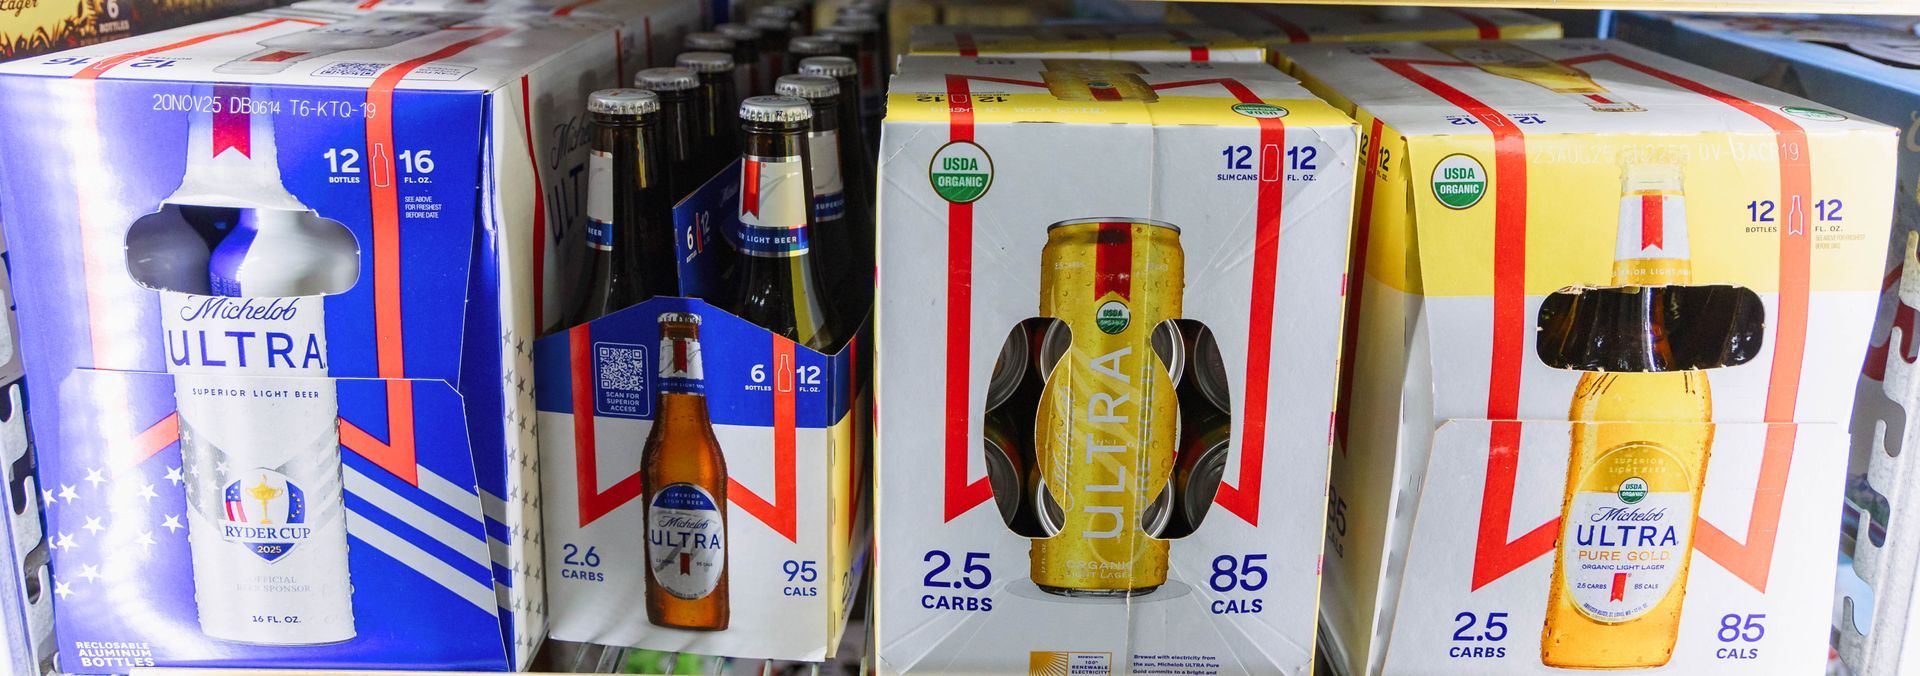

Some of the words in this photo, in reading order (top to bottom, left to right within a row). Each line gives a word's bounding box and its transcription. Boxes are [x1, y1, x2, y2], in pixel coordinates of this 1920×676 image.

[107, 0, 119, 18] 6
[153, 94, 222, 113] 20NOV25
[230, 96, 281, 115] DB0614
[290, 100, 376, 118] T6-KTQ-19
[1446, 117, 1478, 125] 12
[1514, 116, 1546, 124] 12
[323, 148, 360, 173] 12
[398, 149, 434, 174] 16
[944, 158, 978, 171] USDA
[1222, 145, 1252, 170] 12
[1288, 146, 1317, 170] 12
[1380, 146, 1390, 172] 12
[329, 176, 360, 184] BOTTLES
[938, 176, 983, 188] ORGANIC
[1444, 168, 1475, 180] USDA
[1440, 184, 1480, 194] ORGANIC
[1747, 200, 1775, 222] 12
[1815, 198, 1843, 221] 12
[588, 227, 602, 237] BEER
[686, 225, 694, 250] 6
[746, 234, 770, 244] LIGHT
[774, 236, 797, 244] BEER
[180, 296, 300, 322] Michelob
[1103, 309, 1123, 318] USDA
[168, 330, 325, 370] ULTRA
[750, 364, 766, 383] 6
[796, 365, 820, 384] 12
[192, 388, 246, 397] SUPERIOR
[253, 390, 288, 398] LIGHT
[294, 390, 320, 398] BEER
[606, 398, 640, 406] SUPERIOR
[1138, 364, 1154, 447] GOLD
[1082, 346, 1132, 538] ULTRA
[1590, 506, 1668, 522] Michelob
[658, 516, 709, 530] Michelob
[225, 525, 278, 539] RYDER
[280, 528, 311, 539] CUP
[651, 530, 721, 550] ULTRA
[1577, 524, 1677, 547] ULTRA
[257, 546, 282, 554] 2025
[563, 543, 600, 568] 2.6
[1578, 550, 1621, 561] PURE
[1627, 550, 1670, 561] GOLD
[562, 568, 604, 582] CARBS
[783, 560, 818, 582] 95
[923, 550, 992, 590] 2.5
[1209, 554, 1268, 592] 85
[263, 584, 312, 592] SPONSOR
[783, 586, 817, 597] CALS
[921, 594, 992, 612] CARBS
[1211, 598, 1263, 614] CALS
[284, 616, 302, 624] OZ.
[1452, 612, 1508, 642] 2.5
[1717, 614, 1766, 642] 85
[75, 642, 150, 650] RECLOSABLE
[78, 649, 152, 657] ALUMINUM
[1449, 646, 1506, 658] CARBS
[1716, 648, 1758, 659] CALS
[81, 657, 155, 667] BOTTLES
